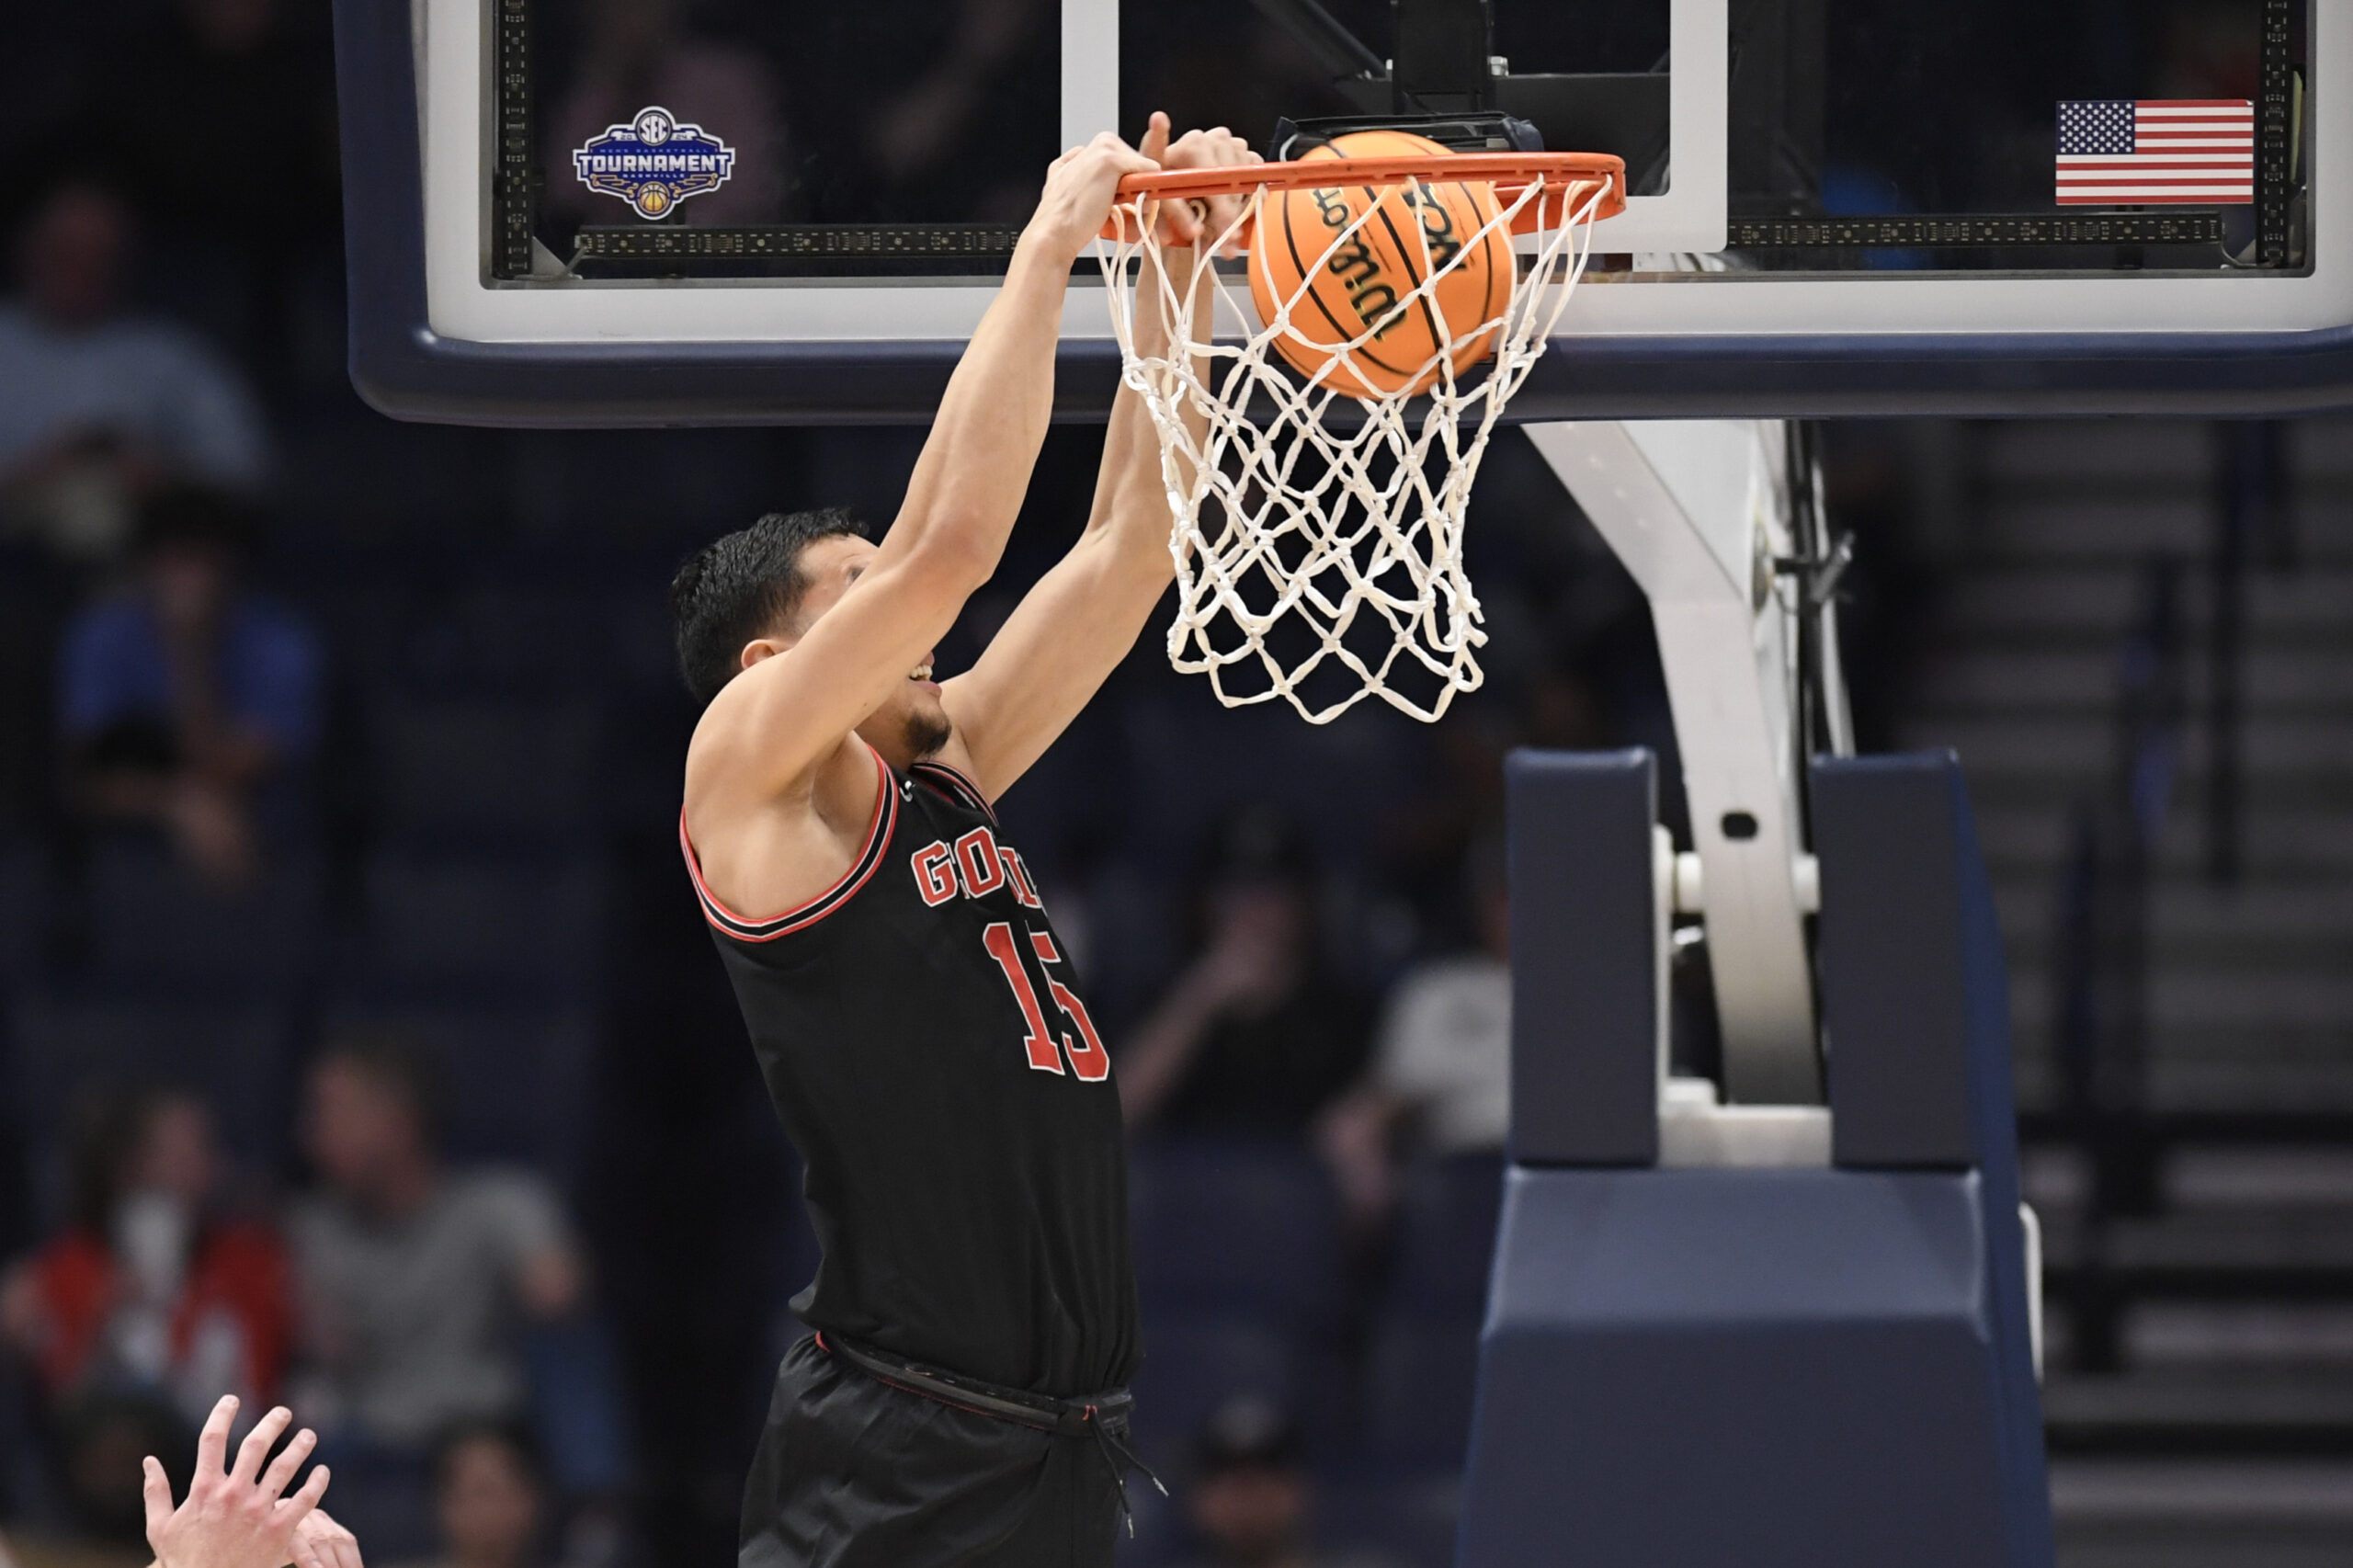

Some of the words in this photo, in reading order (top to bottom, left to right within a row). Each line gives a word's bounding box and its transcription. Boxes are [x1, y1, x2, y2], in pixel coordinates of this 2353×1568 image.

[640, 115, 668, 144] SEC
[579, 154, 730, 176] TOURNAMENT
[983, 921, 1110, 1082] 15
